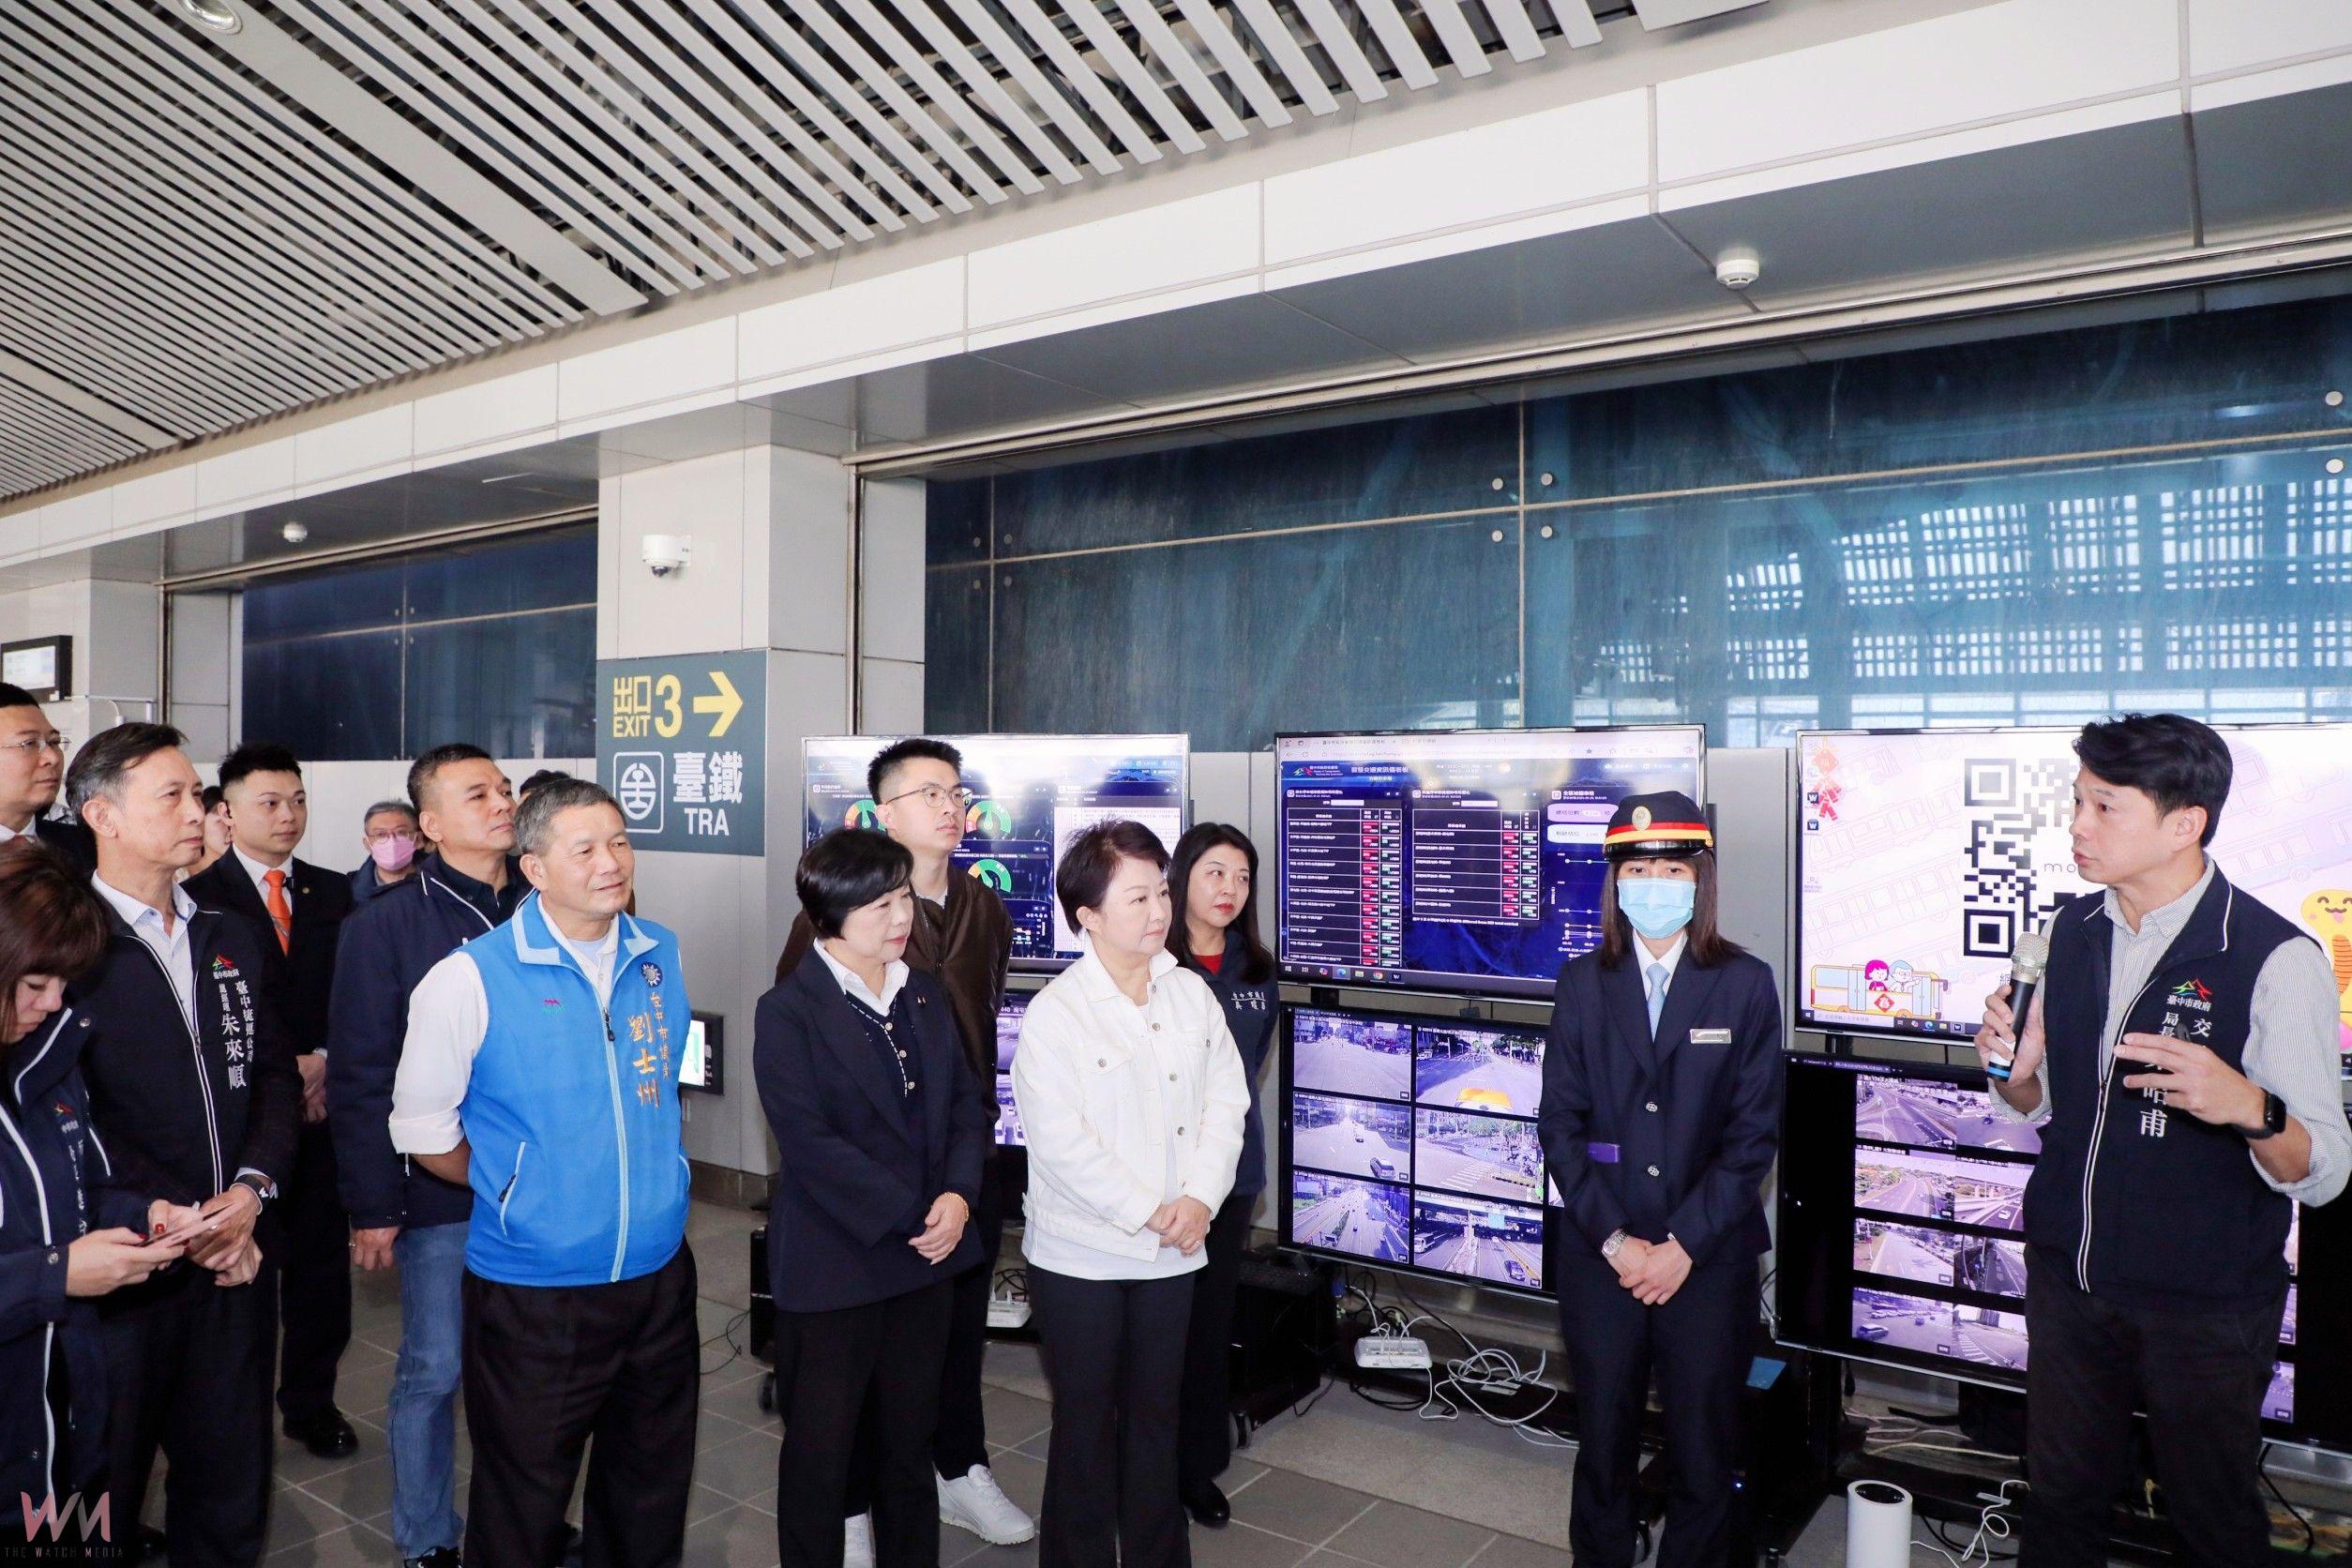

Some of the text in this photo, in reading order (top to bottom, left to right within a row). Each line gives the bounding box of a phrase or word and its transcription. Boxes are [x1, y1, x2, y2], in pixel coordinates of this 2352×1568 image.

[612, 714, 651, 738] EXIT
[613, 674, 683, 738] 出口 3
[672, 750, 743, 804] 臺鐵
[684, 807, 730, 836] TRA
[2166, 994, 2213, 1013] 臺中市政府
[221, 1013, 248, 1091] 朱來順
[627, 1012, 660, 1108] 劉士州
